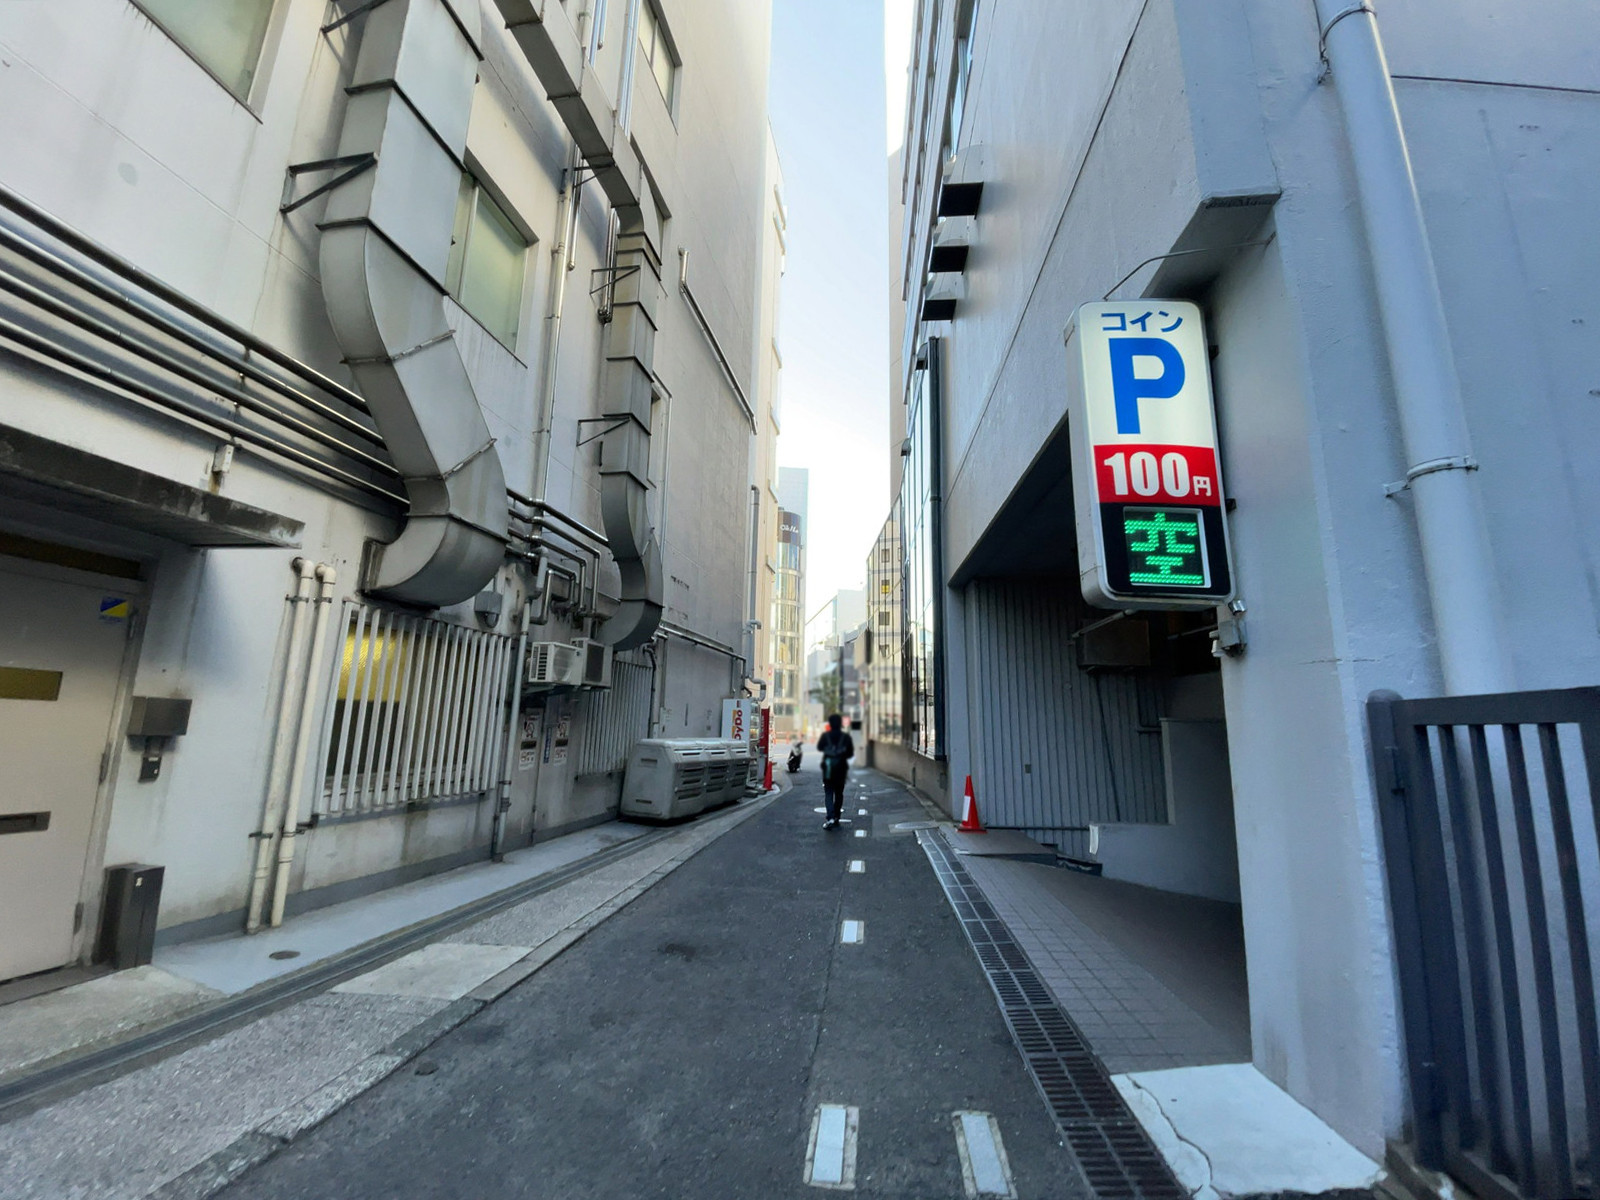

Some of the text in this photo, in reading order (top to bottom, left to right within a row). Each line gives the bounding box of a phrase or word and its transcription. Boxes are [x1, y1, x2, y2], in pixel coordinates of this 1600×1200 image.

[1101, 311, 1183, 332] コイン
[1108, 337, 1186, 434] P
[1104, 451, 1212, 497] 100円
[1124, 512, 1204, 585] 空
